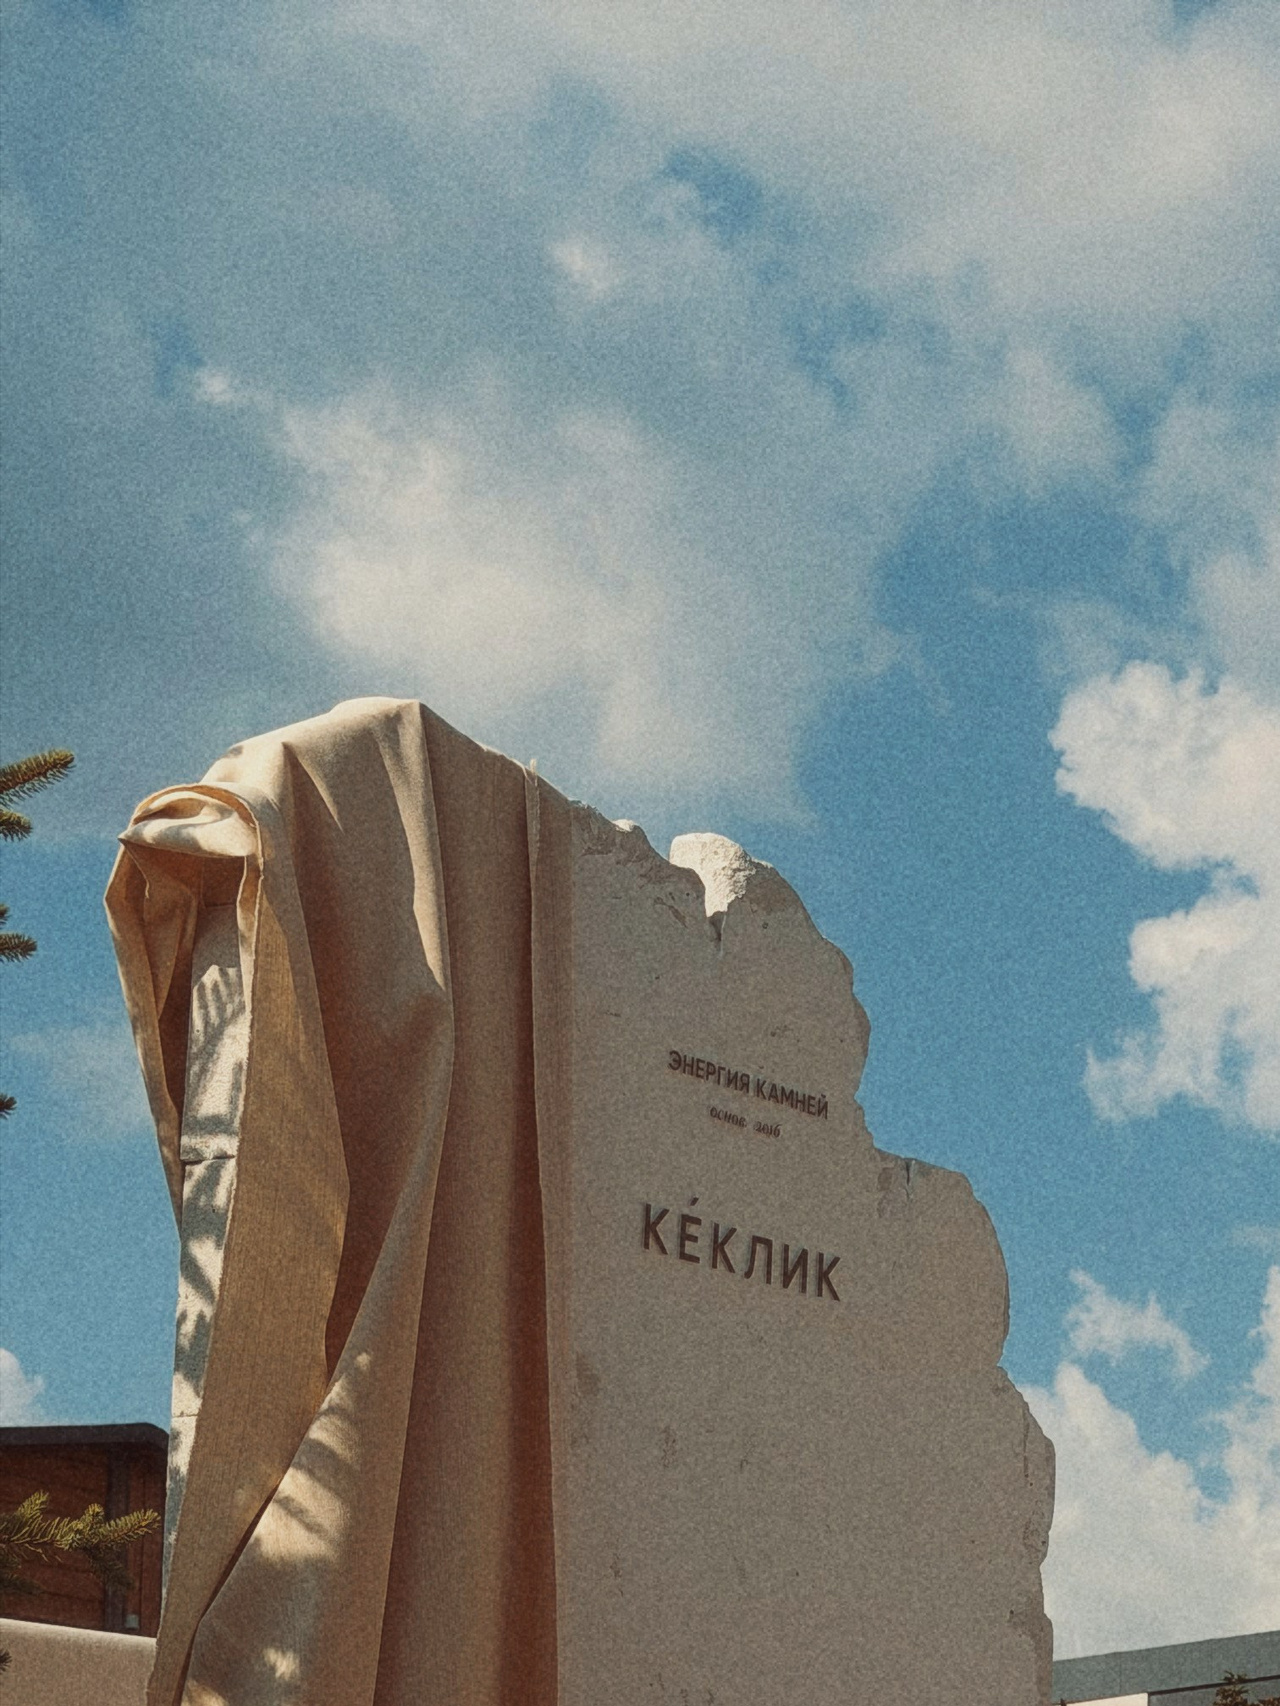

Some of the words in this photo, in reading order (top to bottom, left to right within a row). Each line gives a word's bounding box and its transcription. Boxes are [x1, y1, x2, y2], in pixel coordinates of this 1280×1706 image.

[668, 1050, 750, 1094] ЭНЕРГИЯ
[756, 1078, 829, 1120] КАМНЕЙ
[754, 1121, 782, 1139] 2016
